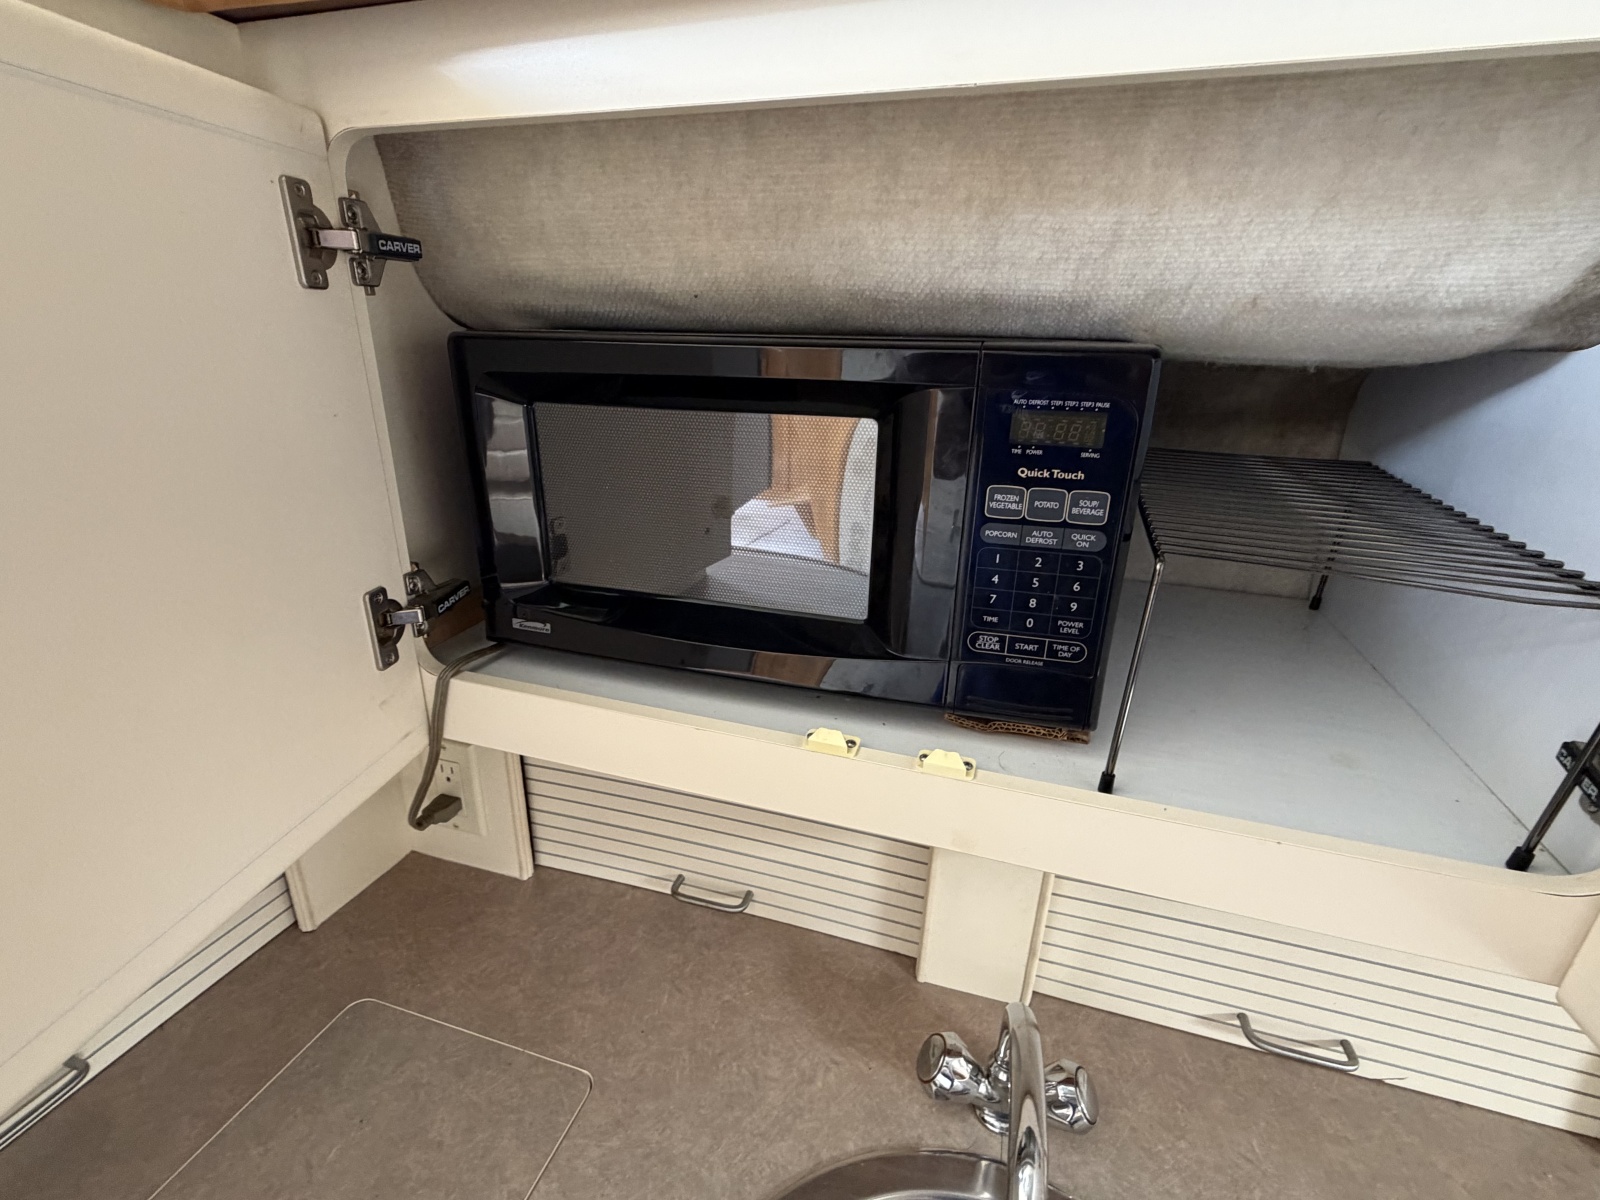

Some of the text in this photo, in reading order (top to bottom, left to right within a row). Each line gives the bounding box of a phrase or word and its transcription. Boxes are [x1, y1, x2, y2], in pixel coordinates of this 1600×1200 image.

[378, 239, 421, 254] CARVER
[1017, 467, 1085, 480] Quick Touch
[993, 493, 1020, 502] FROZEN
[989, 501, 1022, 510] VEGETABLE
[1034, 500, 1060, 509] POTATO
[1078, 499, 1100, 508] SOUP/
[1071, 507, 1104, 517] BEVERAGE
[985, 529, 1018, 539] POPCORN
[1031, 530, 1054, 538] AUTO
[1071, 533, 1097, 542] QUICK
[1025, 536, 1058, 545] DEFROST
[995, 553, 1000, 564] 1
[1034, 557, 1042, 567] 2
[1076, 560, 1084, 571] 3
[991, 574, 999, 585] 4
[1031, 577, 1039, 588] 5
[1072, 581, 1081, 592] 6
[437, 585, 471, 614] CARVER
[989, 594, 997, 604] 7
[1028, 598, 1037, 608] 8
[1070, 602, 1078, 612] 9
[982, 615, 999, 623] TIME
[1026, 618, 1034, 628] 0
[1057, 620, 1084, 629] POWER
[1059, 627, 1080, 635] LEVEL
[978, 635, 999, 643] STOP
[975, 642, 1000, 651] CLEAR
[1014, 643, 1039, 652] START
[1052, 643, 1069, 652] TIME
[1558, 748, 1599, 802] CAER
